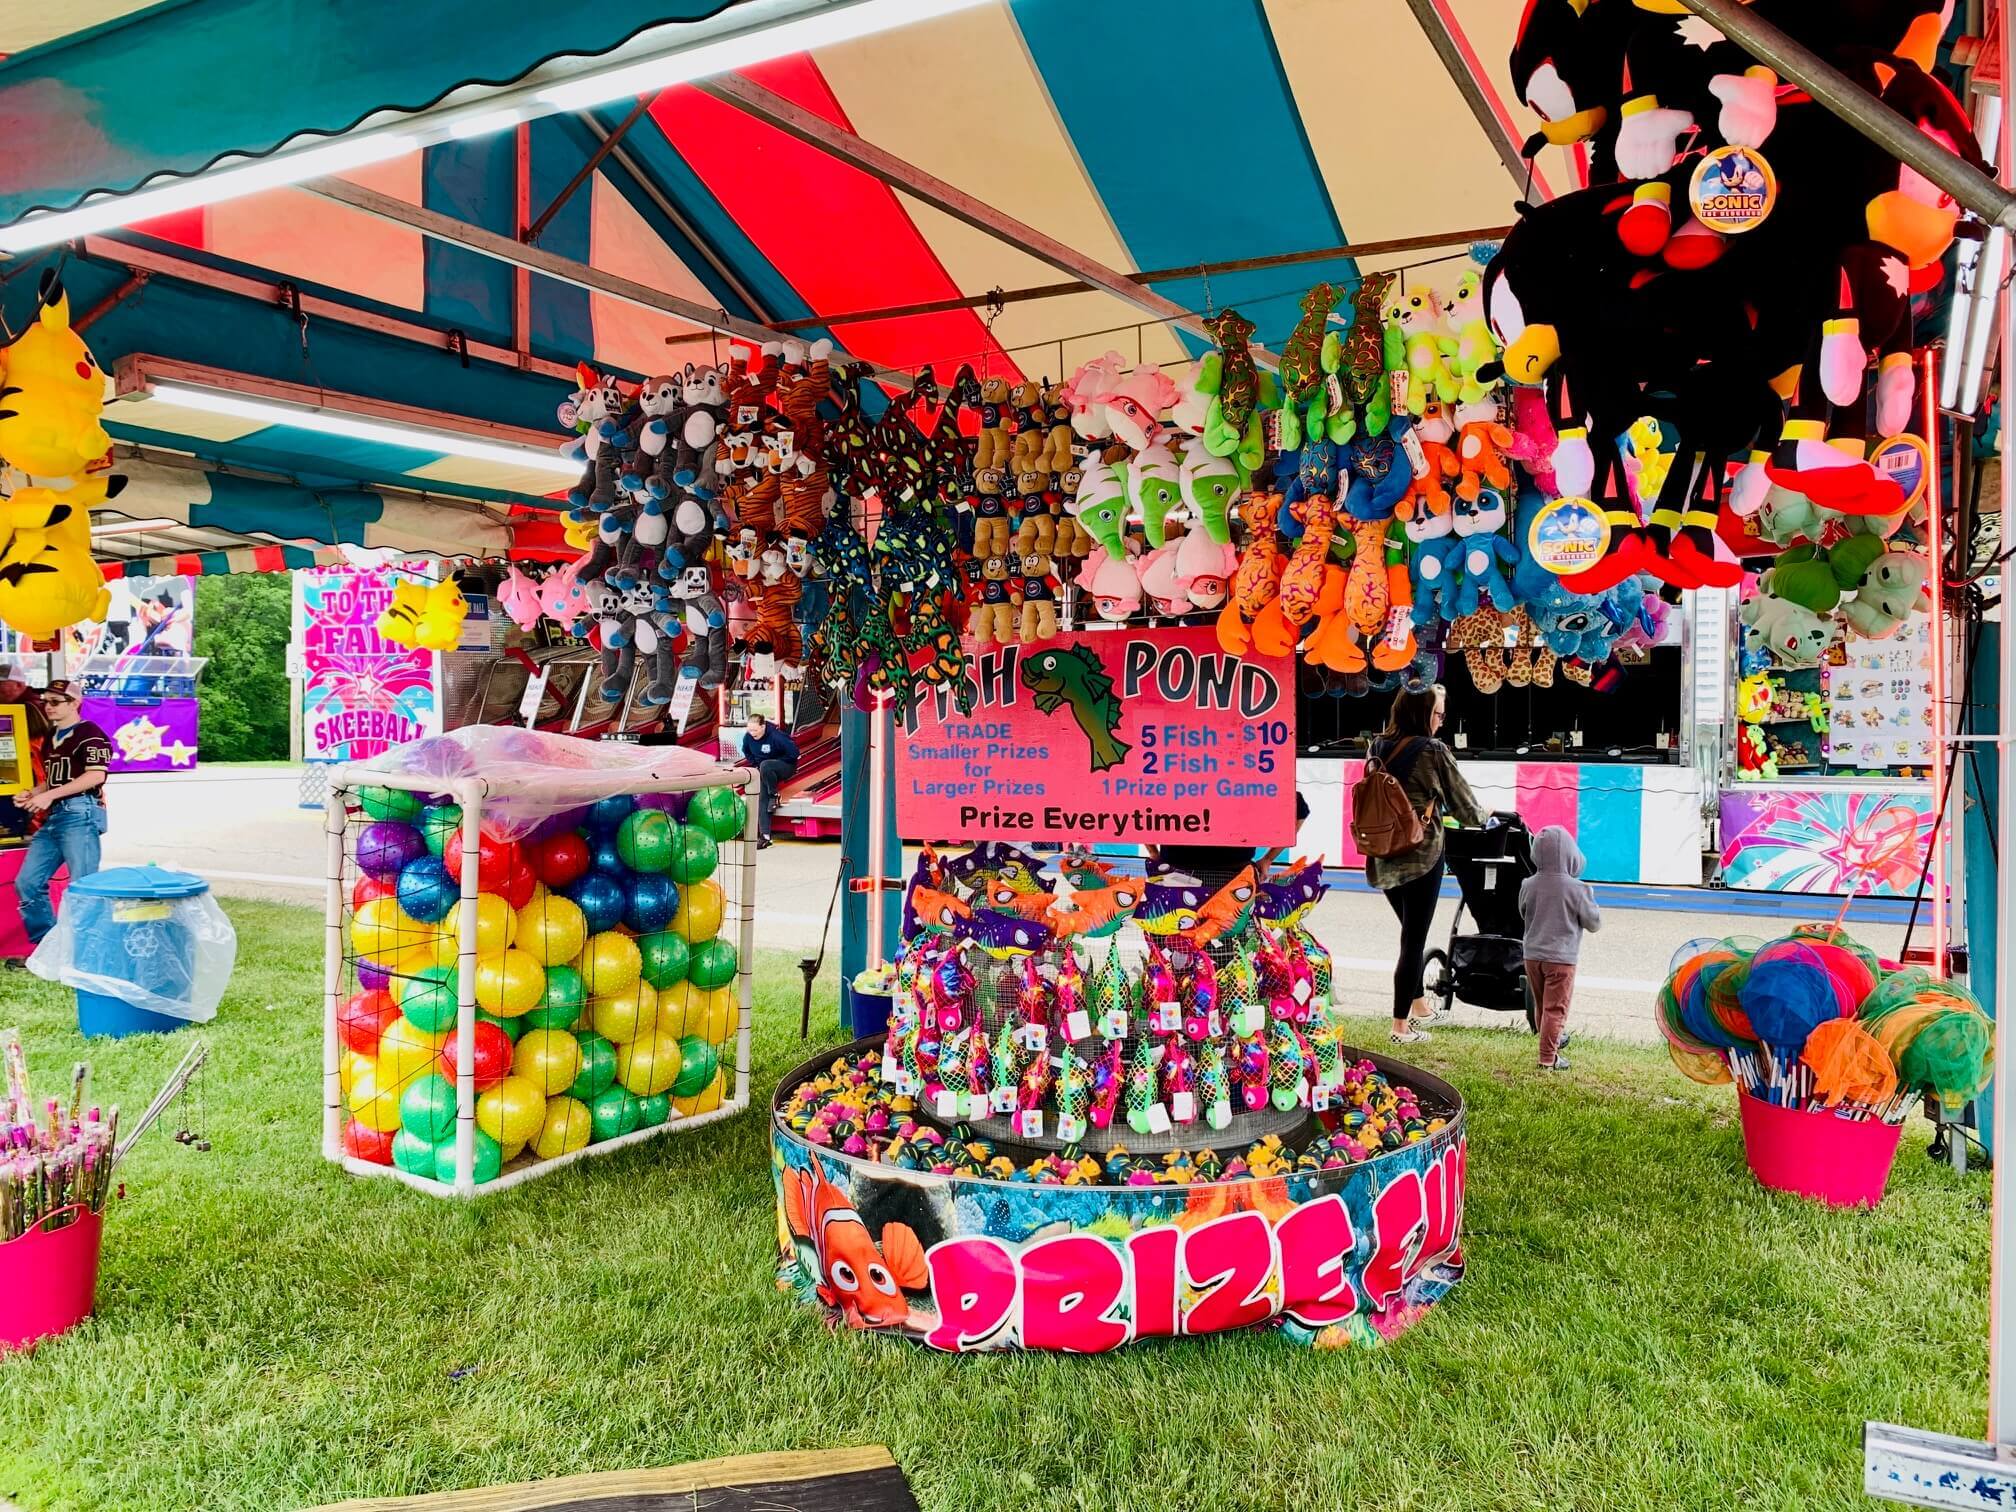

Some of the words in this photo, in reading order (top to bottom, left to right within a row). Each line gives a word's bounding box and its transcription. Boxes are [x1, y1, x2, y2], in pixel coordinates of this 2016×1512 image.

[1702, 194, 1762, 210] SONIC
[1541, 541, 1595, 553] SONIC
[322, 591, 351, 613] TO
[361, 590, 394, 614] TH
[904, 644, 1020, 739] FISH
[1123, 640, 1280, 719] POND
[944, 723, 1012, 740] TRADE
[1141, 725, 1156, 747] 5
[1164, 724, 1217, 747] Fish
[1243, 721, 1287, 745] $10
[909, 744, 979, 760] Smaller
[986, 744, 1049, 759] Prizes
[1143, 751, 1158, 774] 2
[1165, 751, 1218, 773] Fish
[1244, 750, 1274, 773] $5
[964, 761, 991, 777] for
[913, 780, 976, 798] Larger
[984, 780, 1046, 796] Prizes
[1103, 780, 1109, 795] 1
[1116, 779, 1167, 796] Prize
[1174, 781, 1208, 800] per
[1217, 779, 1278, 797] Game
[961, 806, 1034, 829] Prize
[1045, 807, 1211, 836] Everytime!
[924, 1193, 1358, 1353] PRIZE
[1362, 1133, 1467, 1312] FU
